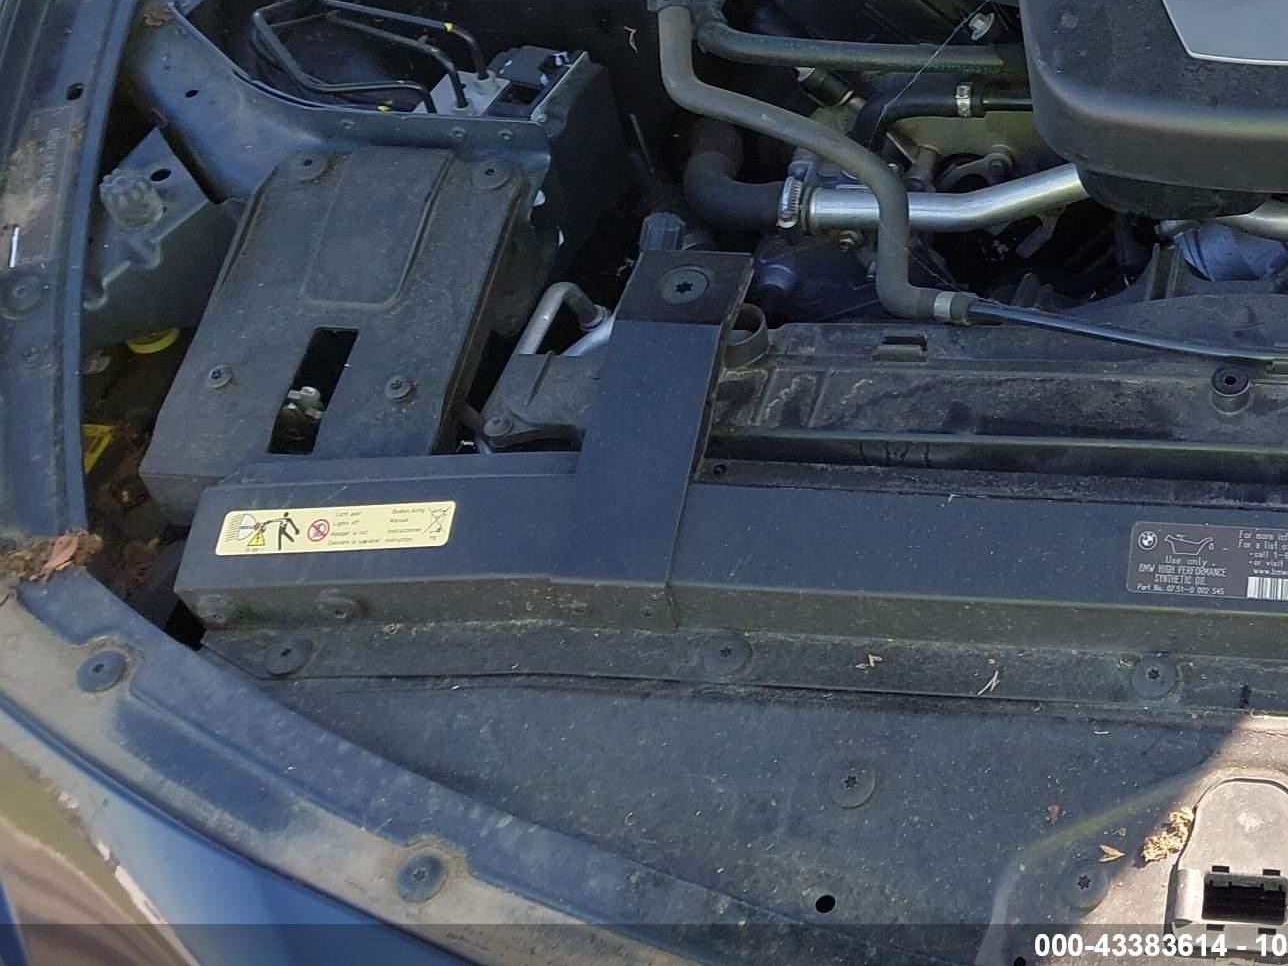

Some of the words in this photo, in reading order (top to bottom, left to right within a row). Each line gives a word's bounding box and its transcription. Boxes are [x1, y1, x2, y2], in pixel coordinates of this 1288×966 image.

[1239, 530, 1252, 539] For
[1255, 532, 1274, 541] more
[1238, 539, 1250, 549] For
[1264, 541, 1278, 550] list
[1165, 555, 1181, 564] Use
[1266, 559, 1284, 568] visit
[1138, 563, 1155, 573] BMW
[1158, 564, 1175, 574] HIGH
[1178, 566, 1228, 578] PERFORMANCE
[1154, 574, 1192, 585] SYNTHETIC
[1194, 576, 1208, 585] OIL
[1137, 583, 1151, 591] Part
